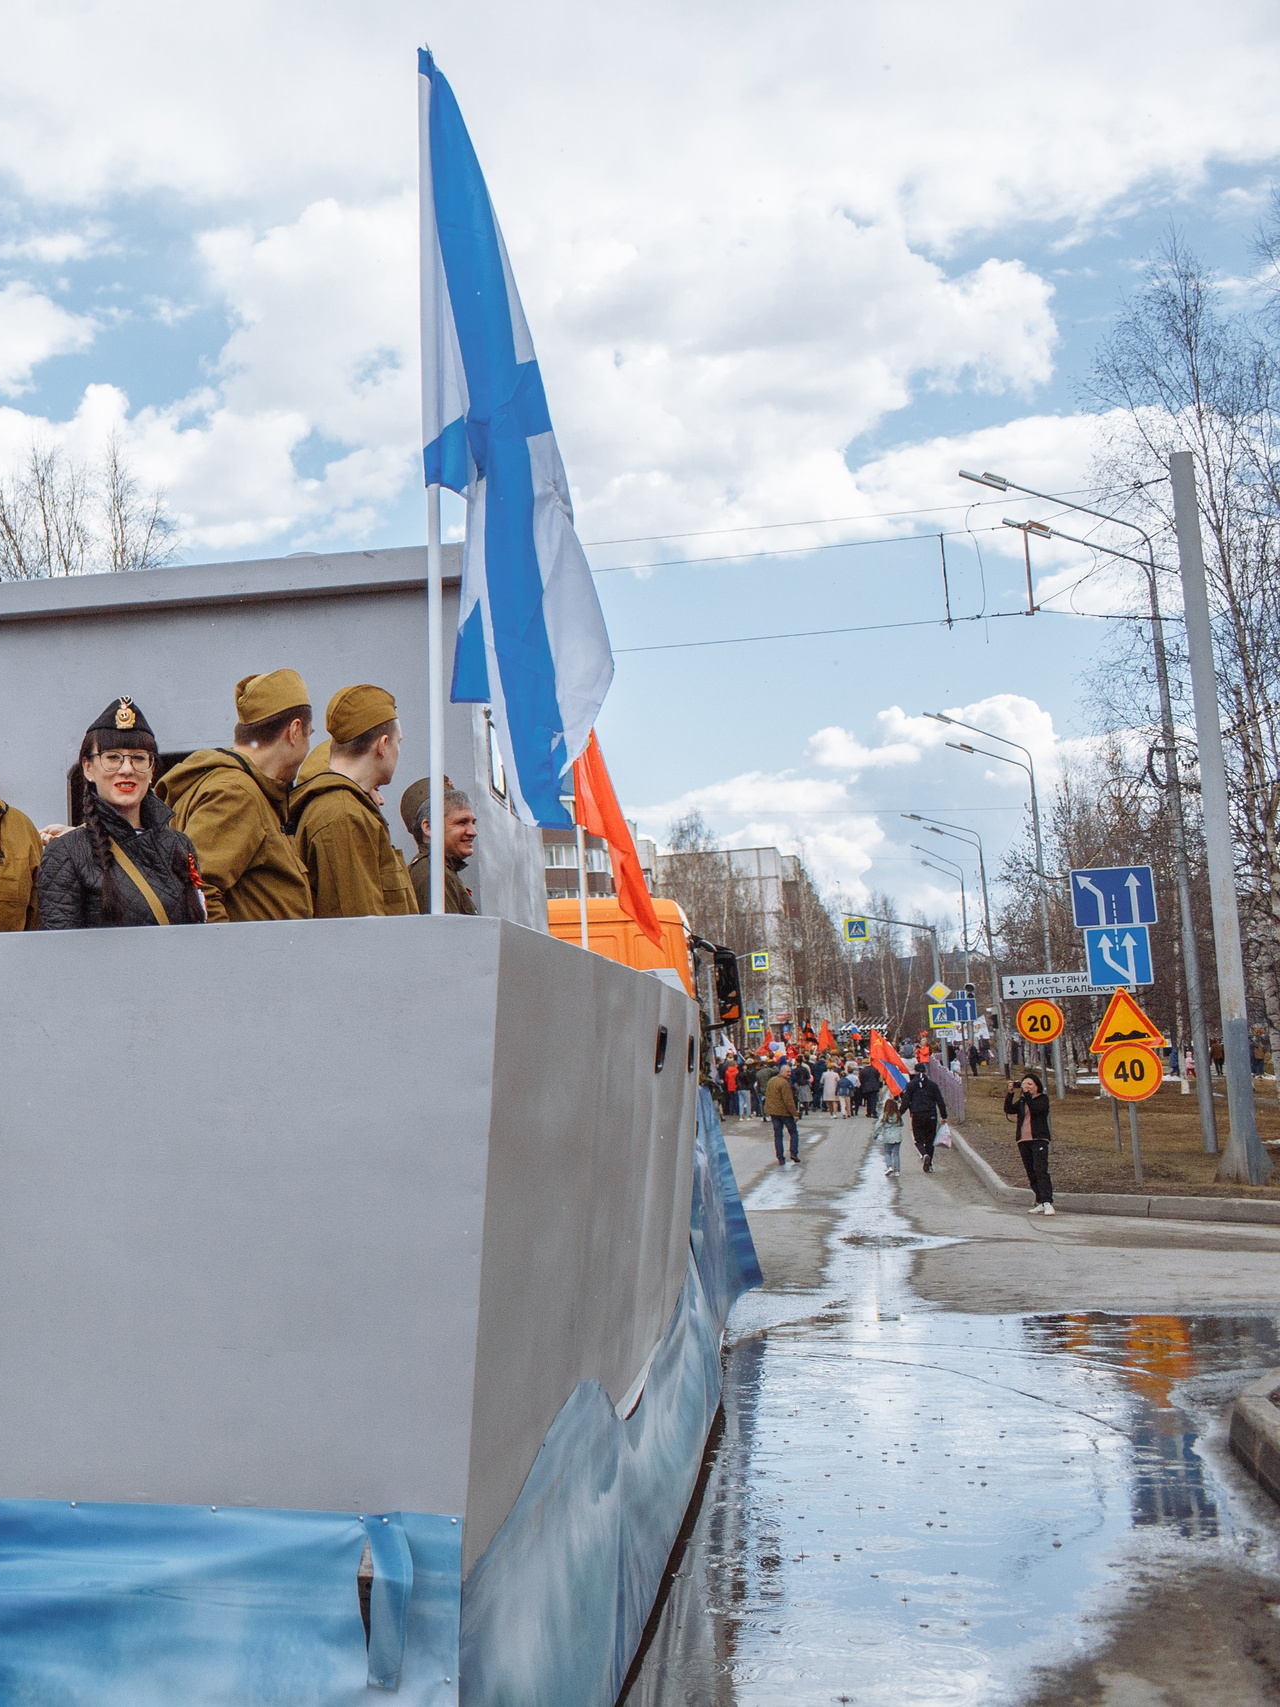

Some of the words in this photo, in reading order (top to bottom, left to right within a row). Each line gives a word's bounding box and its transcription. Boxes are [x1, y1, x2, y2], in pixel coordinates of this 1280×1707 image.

[1021, 975, 1088, 987] ул.НЕФТЯНИ
[1027, 1014, 1051, 1032] 20
[1114, 1059, 1145, 1083] 40
